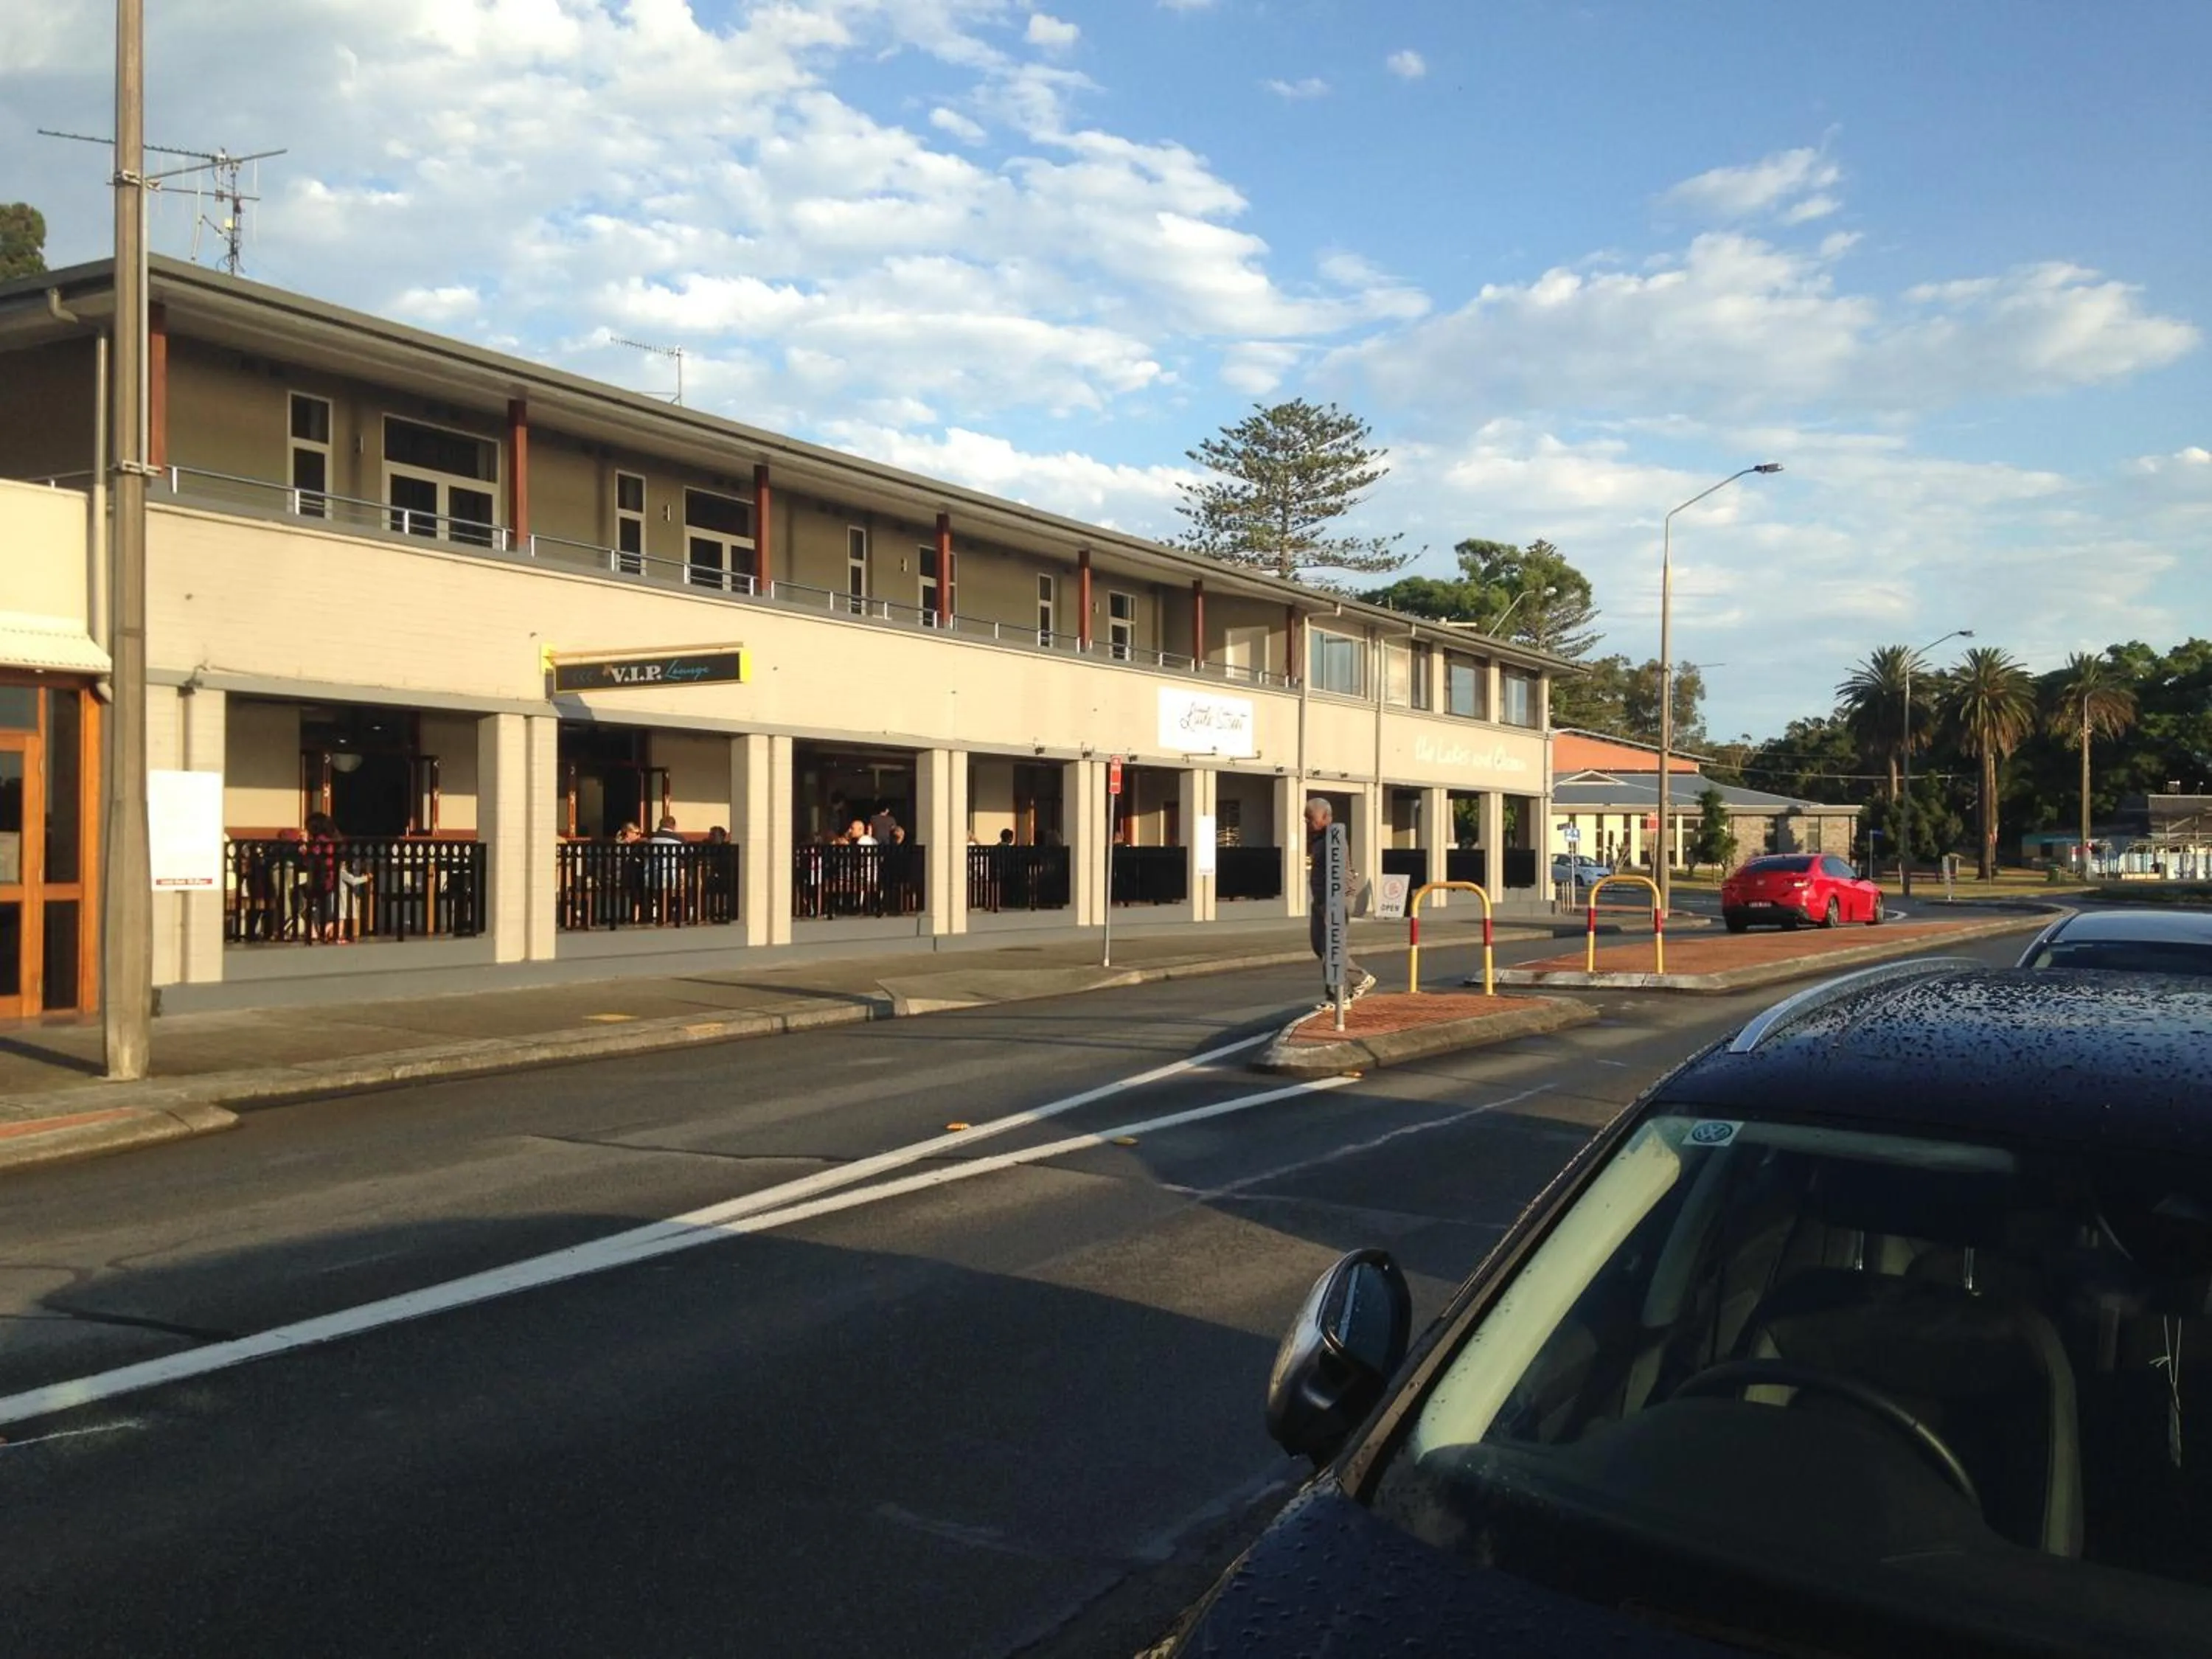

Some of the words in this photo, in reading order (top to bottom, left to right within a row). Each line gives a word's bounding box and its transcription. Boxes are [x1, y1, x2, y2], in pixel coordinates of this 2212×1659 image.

[1330, 827, 1341, 897] KEEP
[1380, 902, 1401, 912] OPEN
[1330, 911, 1341, 982] LEFT
